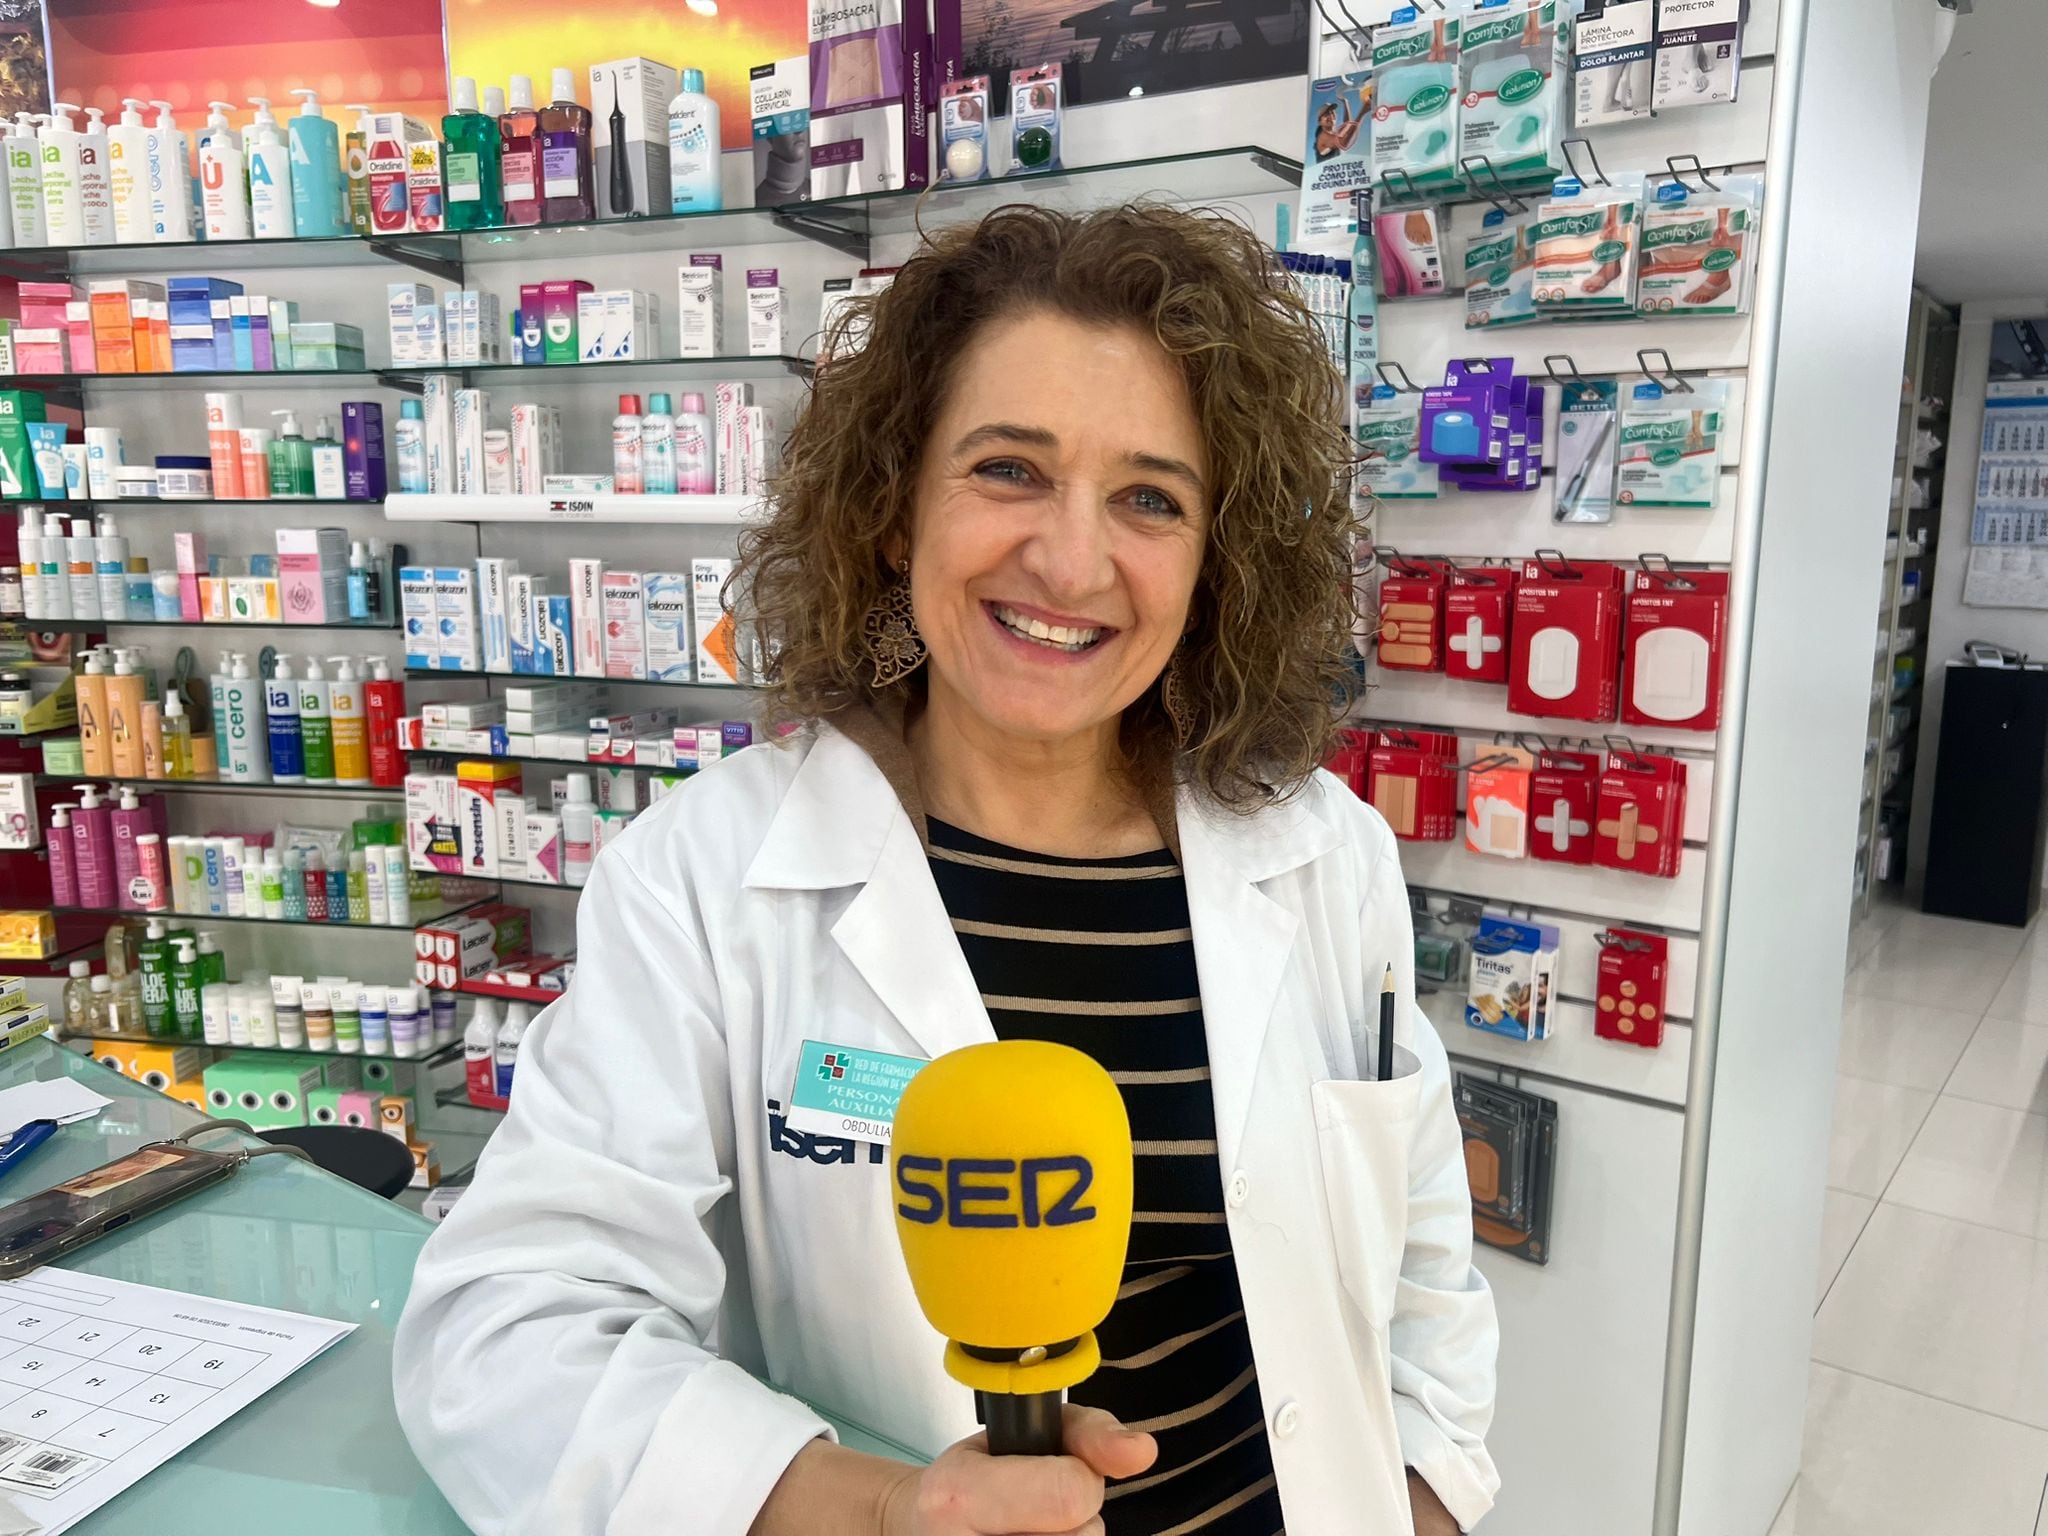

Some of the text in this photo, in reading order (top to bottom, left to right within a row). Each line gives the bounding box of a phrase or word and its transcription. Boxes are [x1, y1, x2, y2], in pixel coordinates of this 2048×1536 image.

[1664, 0, 1715, 14] PROTECTOR
[812, 4, 874, 27] LUMBOSACRA
[1580, 25, 1612, 37] LÁMINA
[1580, 29, 1635, 46] PROTECTORA
[1662, 34, 1698, 46] JUANETE
[1580, 56, 1608, 68] DOLOR
[1608, 50, 1645, 64] PLANTAR
[592, 70, 602, 82] ia
[754, 88, 792, 104] COLLARÍN
[912, 51, 921, 136] LUMBOSACRA
[754, 100, 790, 114] CERVICAL
[10, 146, 32, 168] ia
[42, 141, 60, 162] ia
[79, 142, 96, 165] ia
[370, 162, 402, 172] Oraldine
[1322, 161, 1364, 174] PROTEGE
[410, 177, 438, 186] Oraldine
[1318, 169, 1366, 182] COMO UNA
[1311, 178, 1352, 190] SEGUNDA
[1541, 213, 1598, 235] ComforSil
[1648, 221, 1708, 242] ComforSil
[1446, 372, 1458, 386] ia
[348, 406, 356, 417] ia
[1569, 403, 1609, 411] BETER
[88, 442, 104, 459] ia
[568, 501, 594, 512] ISDIN
[695, 564, 713, 573] Gingi
[1526, 564, 1538, 580] ia
[489, 564, 497, 596] ialozon
[1636, 574, 1650, 590] ia
[605, 588, 640, 600] ialozon
[648, 602, 684, 612] ialozon
[538, 600, 546, 640] ialozon
[556, 632, 564, 672] ialozon
[270, 686, 290, 708] ia
[300, 690, 320, 710] ia
[333, 690, 352, 711] ia
[370, 694, 382, 708] ia
[228, 689, 246, 740] cero
[234, 760, 248, 774] ia
[1610, 754, 1621, 770] ia
[470, 797, 485, 866] Desensin
[206, 848, 218, 886] cero
[463, 932, 493, 951] Lacer
[464, 960, 494, 978] Lacer
[1476, 957, 1512, 974] Tiritas
[854, 1058, 868, 1070] RED
[870, 1060, 880, 1073] DE
[852, 1071, 900, 1090] LA REGIÓN DE
[828, 1098, 894, 1118] AUXILIA
[842, 1118, 892, 1138] OBDULIA
[896, 1154, 1097, 1228] SER
[18, 1317, 41, 1328] 22
[77, 1331, 101, 1342] 21
[138, 1344, 162, 1356] 20
[22, 1360, 44, 1372] 15
[204, 1358, 224, 1370] 19
[84, 1376, 107, 1388] 14
[148, 1392, 170, 1405] 13
[31, 1408, 48, 1420] 8
[98, 1427, 116, 1438] 7
